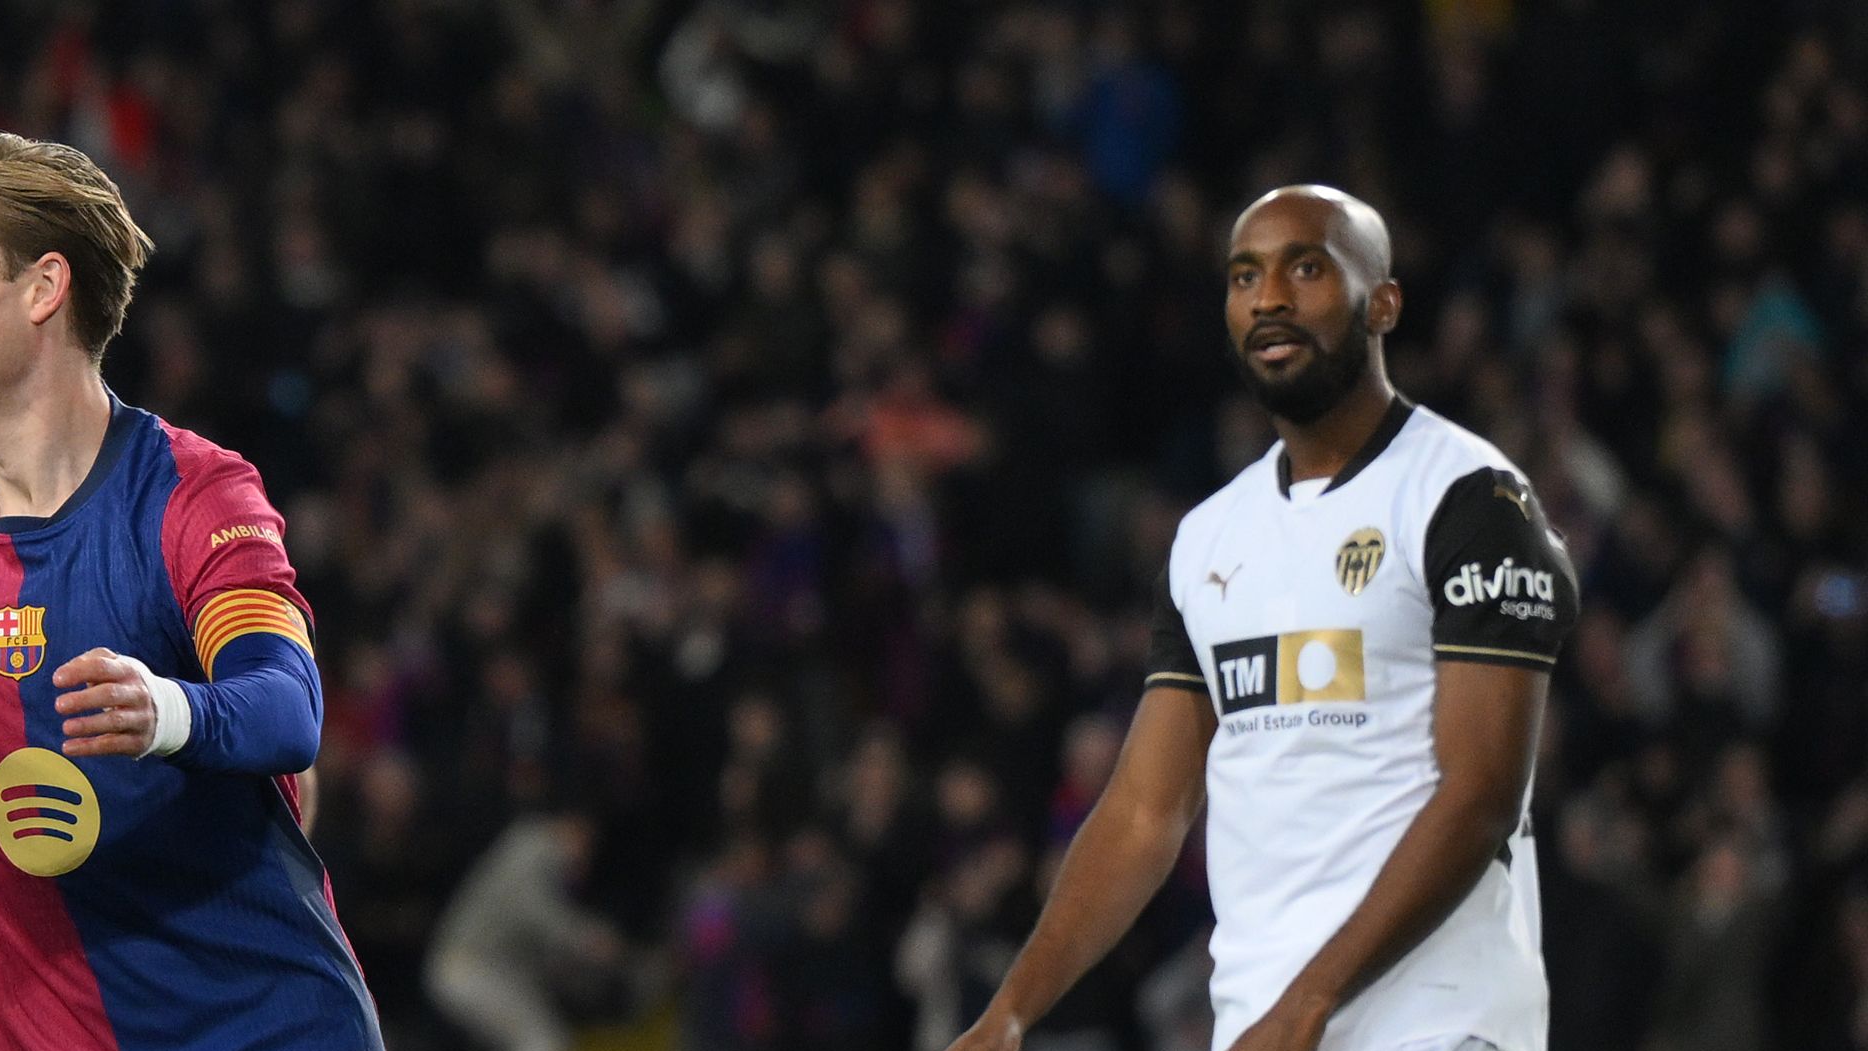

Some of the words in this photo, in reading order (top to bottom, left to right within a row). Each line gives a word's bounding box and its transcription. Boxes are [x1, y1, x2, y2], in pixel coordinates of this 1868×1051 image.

[1443, 556, 1554, 607] divina
[1220, 654, 1266, 700] TM
[1308, 709, 1368, 728] Group
